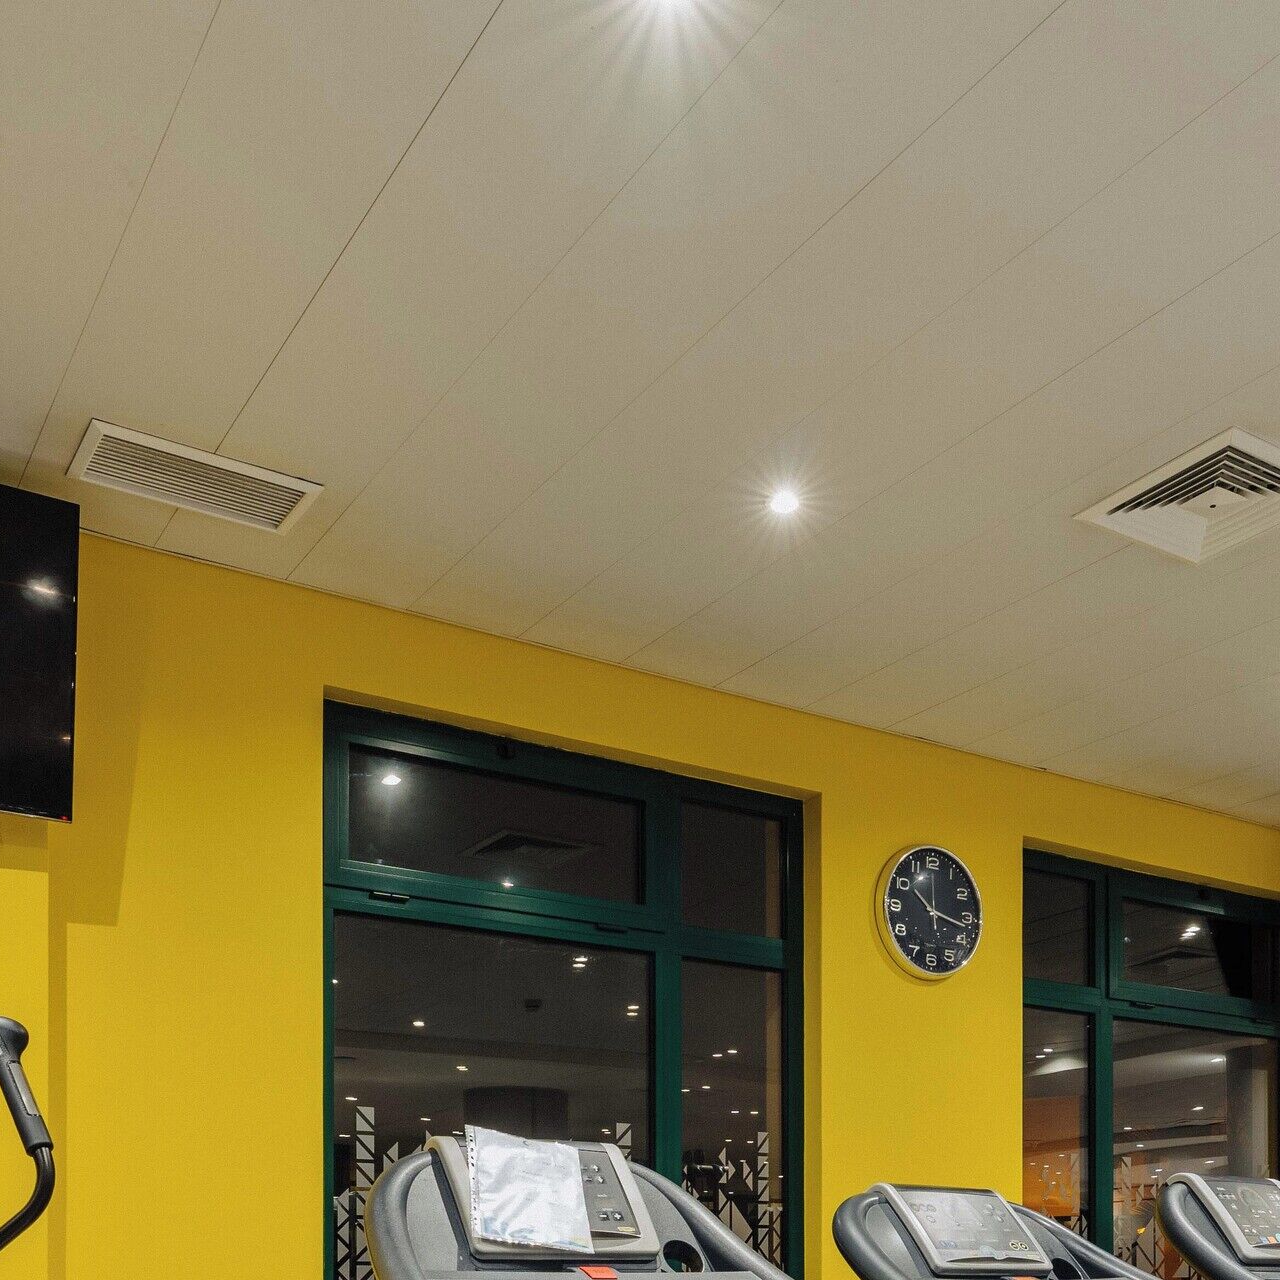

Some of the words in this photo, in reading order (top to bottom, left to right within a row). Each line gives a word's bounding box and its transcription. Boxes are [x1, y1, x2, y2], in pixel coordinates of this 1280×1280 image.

[912, 860, 920, 873] 11
[926, 856, 939, 870] 12
[949, 868, 953, 880] 1
[897, 877, 910, 890] 10
[957, 888, 968, 900] 2
[890, 899, 901, 911] 9
[962, 912, 972, 923] 3
[895, 924, 906, 935] 8
[956, 934, 966, 945] 4
[909, 945, 920, 957] 7
[944, 949, 955, 961] 5
[926, 953, 937, 966] 6
